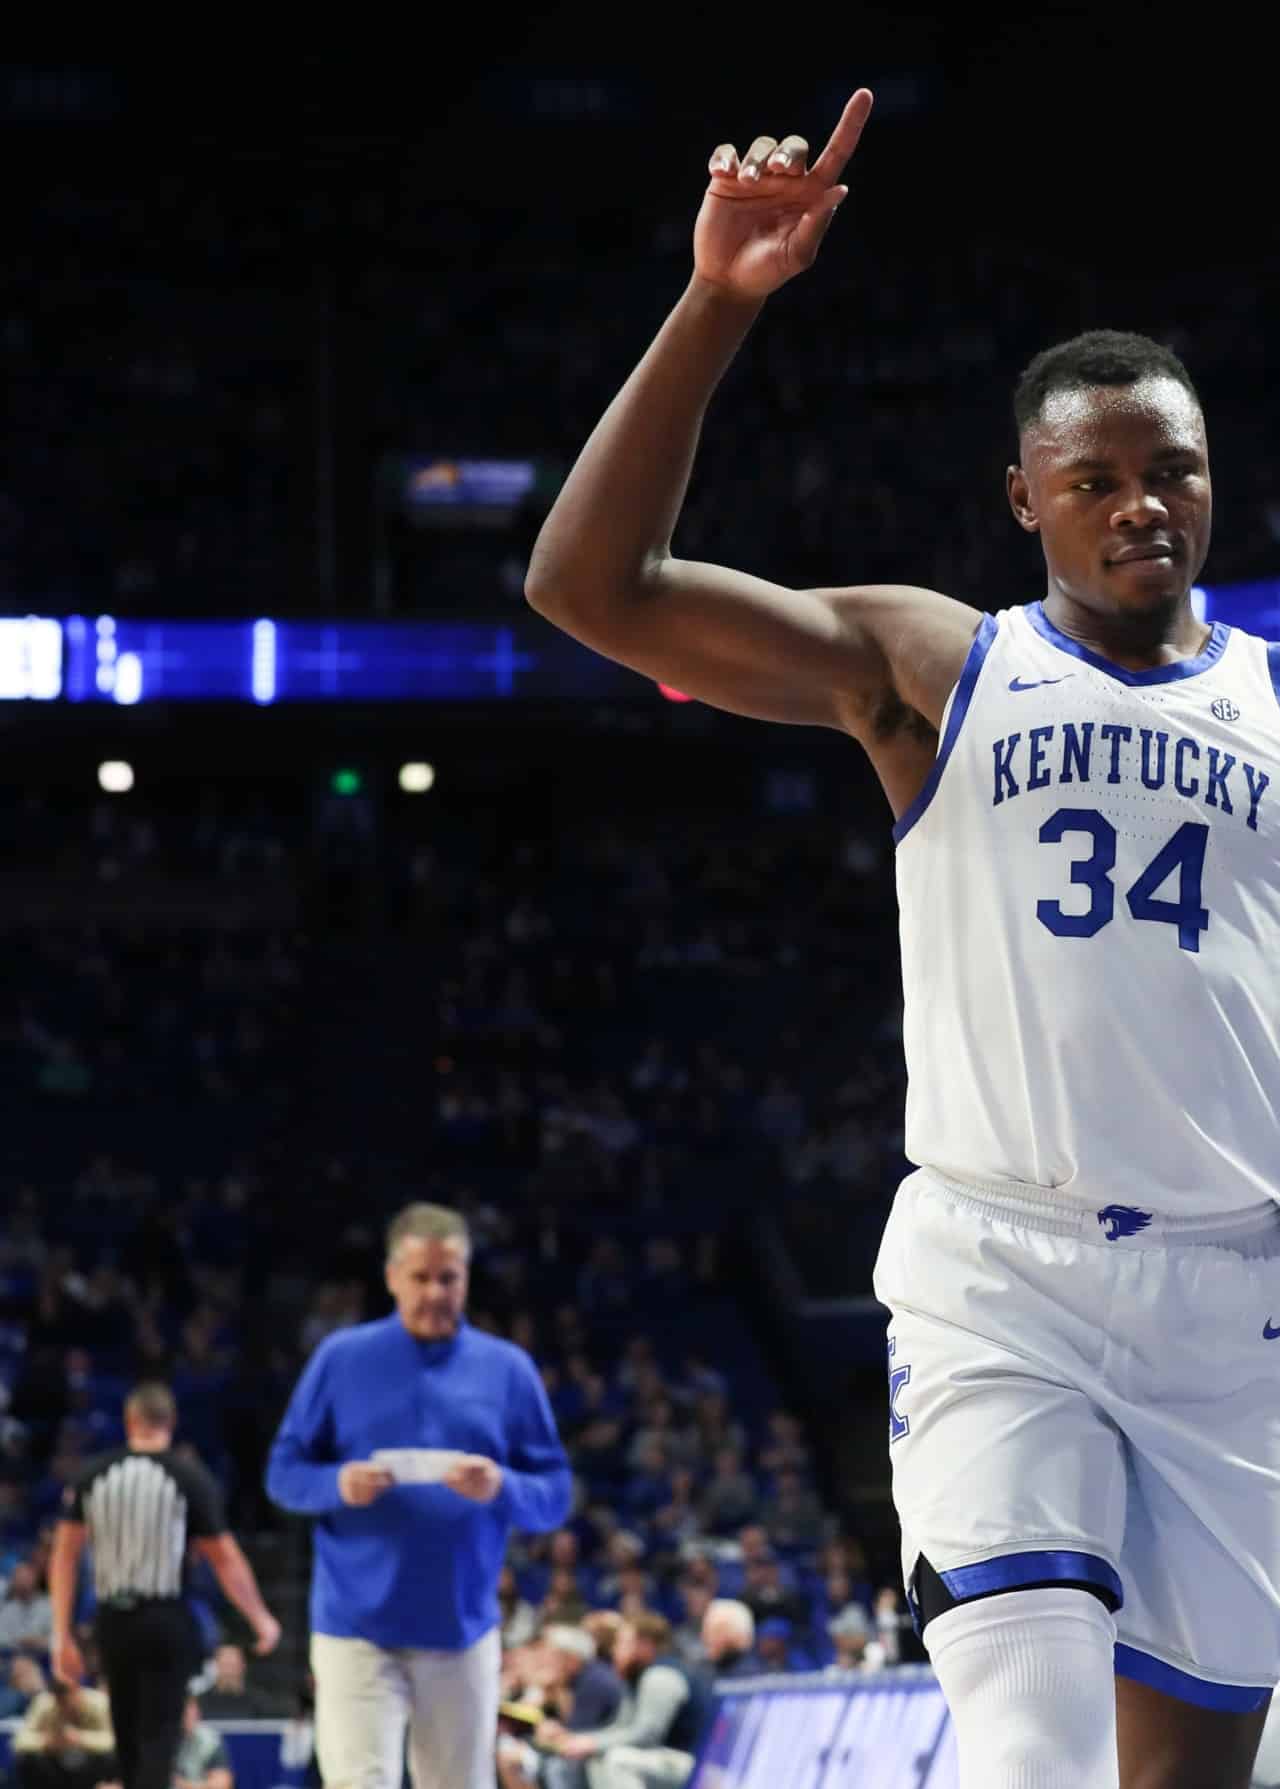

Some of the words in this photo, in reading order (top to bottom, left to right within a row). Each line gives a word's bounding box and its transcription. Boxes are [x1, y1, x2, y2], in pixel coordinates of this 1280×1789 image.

[1211, 698, 1240, 721] SEC
[992, 721, 1271, 832] KENTUCKY
[1036, 807, 1210, 953] 34
